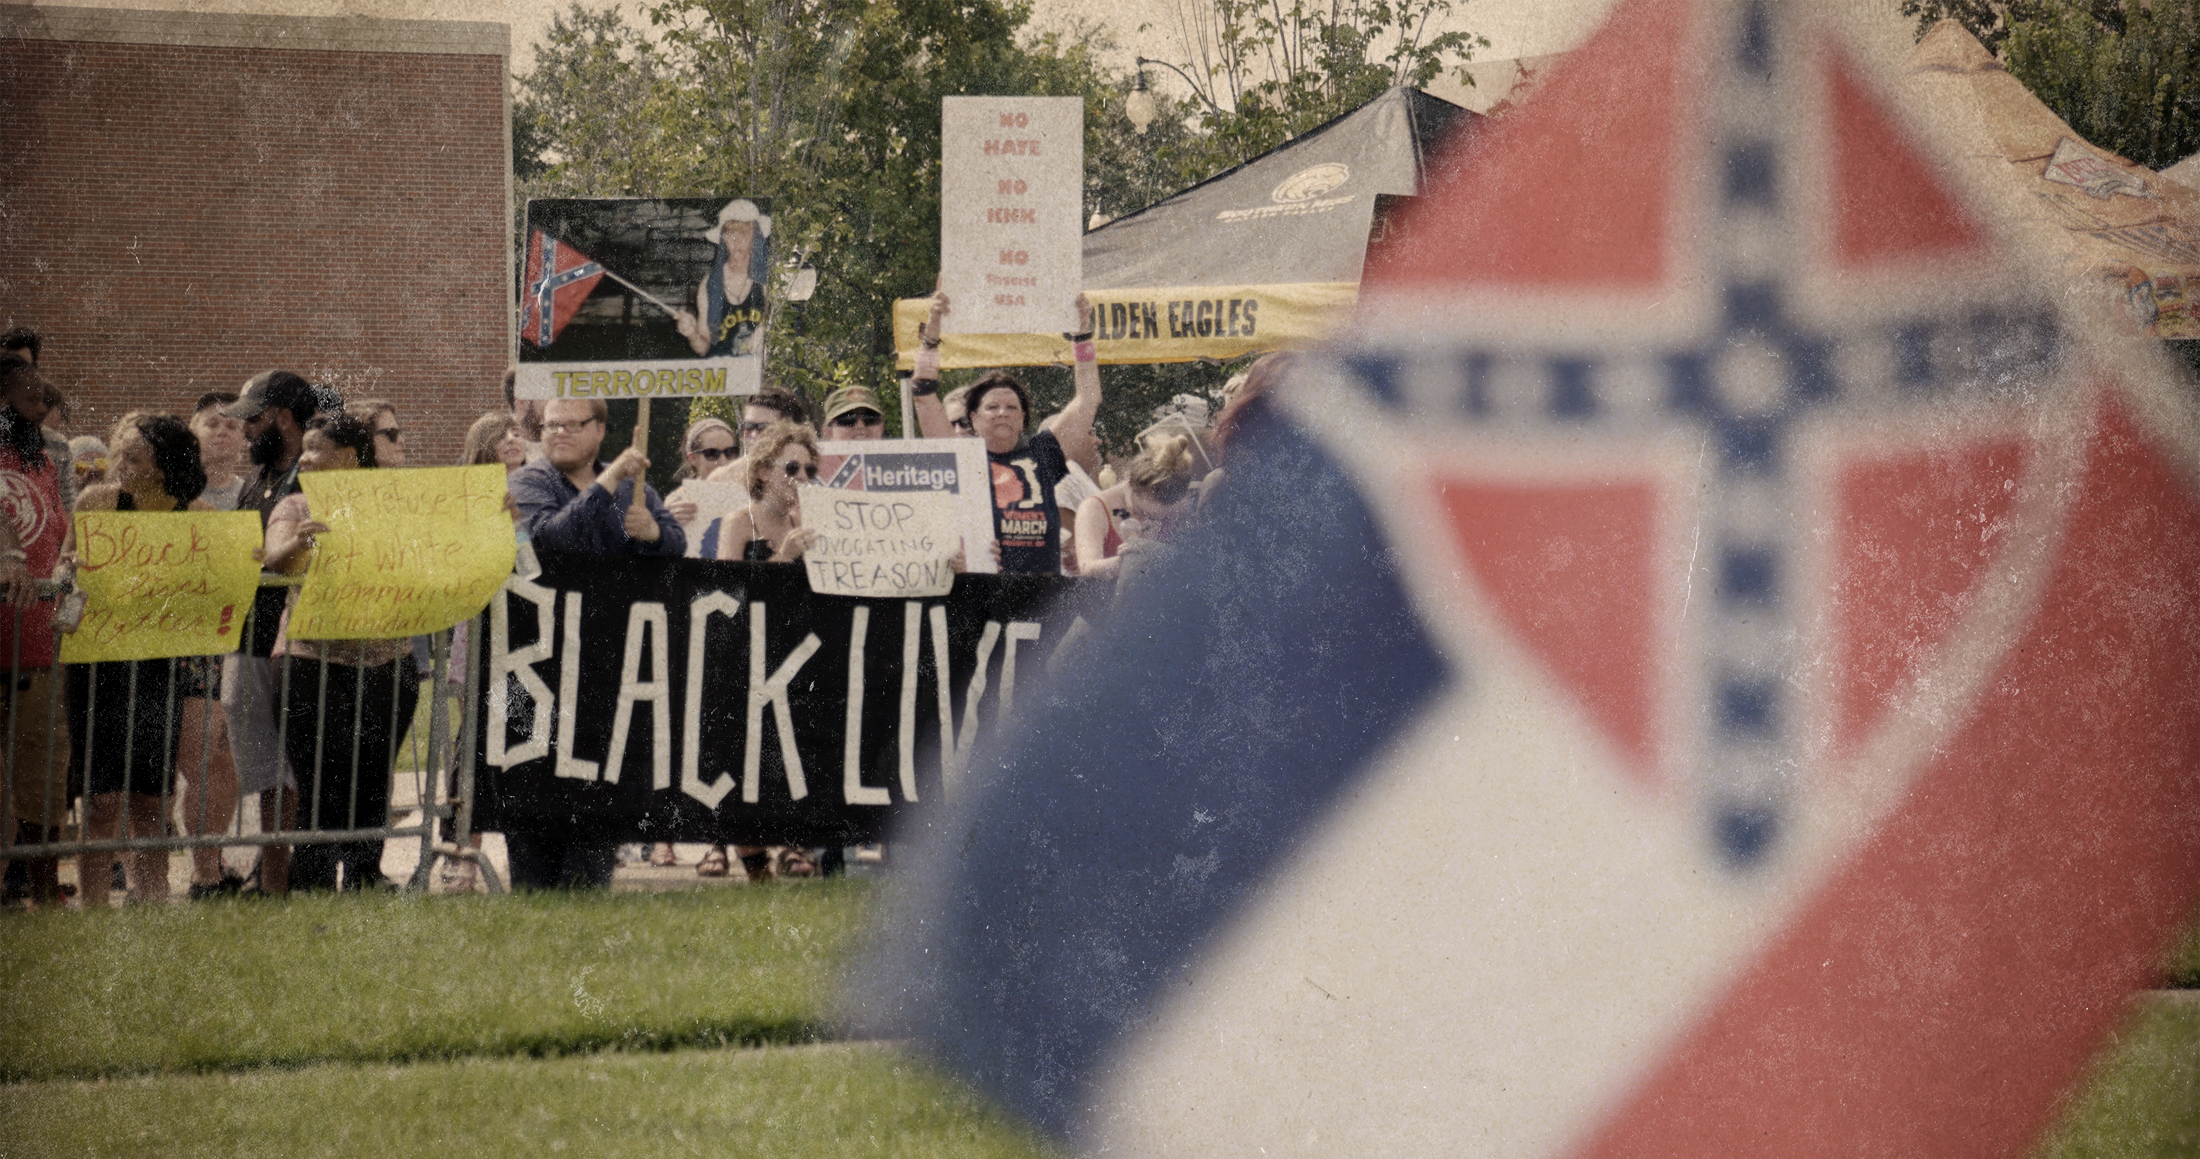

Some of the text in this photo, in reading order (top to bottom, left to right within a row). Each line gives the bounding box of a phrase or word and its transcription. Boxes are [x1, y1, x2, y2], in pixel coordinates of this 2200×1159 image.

[999, 112, 1029, 128] NO
[984, 140, 1040, 155] HATE
[998, 179, 1028, 195] NO
[987, 208, 1036, 224] KKK
[999, 249, 1029, 266] NO
[994, 294, 1026, 306] USA
[1063, 299, 1259, 341] LDEN EAGLES
[553, 368, 727, 397] TERRORISM
[866, 466, 956, 489] Heritage
[834, 500, 914, 533] STOP
[1001, 519, 1047, 534] MARCH
[78, 515, 219, 575] Black
[815, 535, 934, 557] DVOCATING
[811, 559, 950, 590] TREASON!
[486, 575, 1090, 810] BLACK LIV
